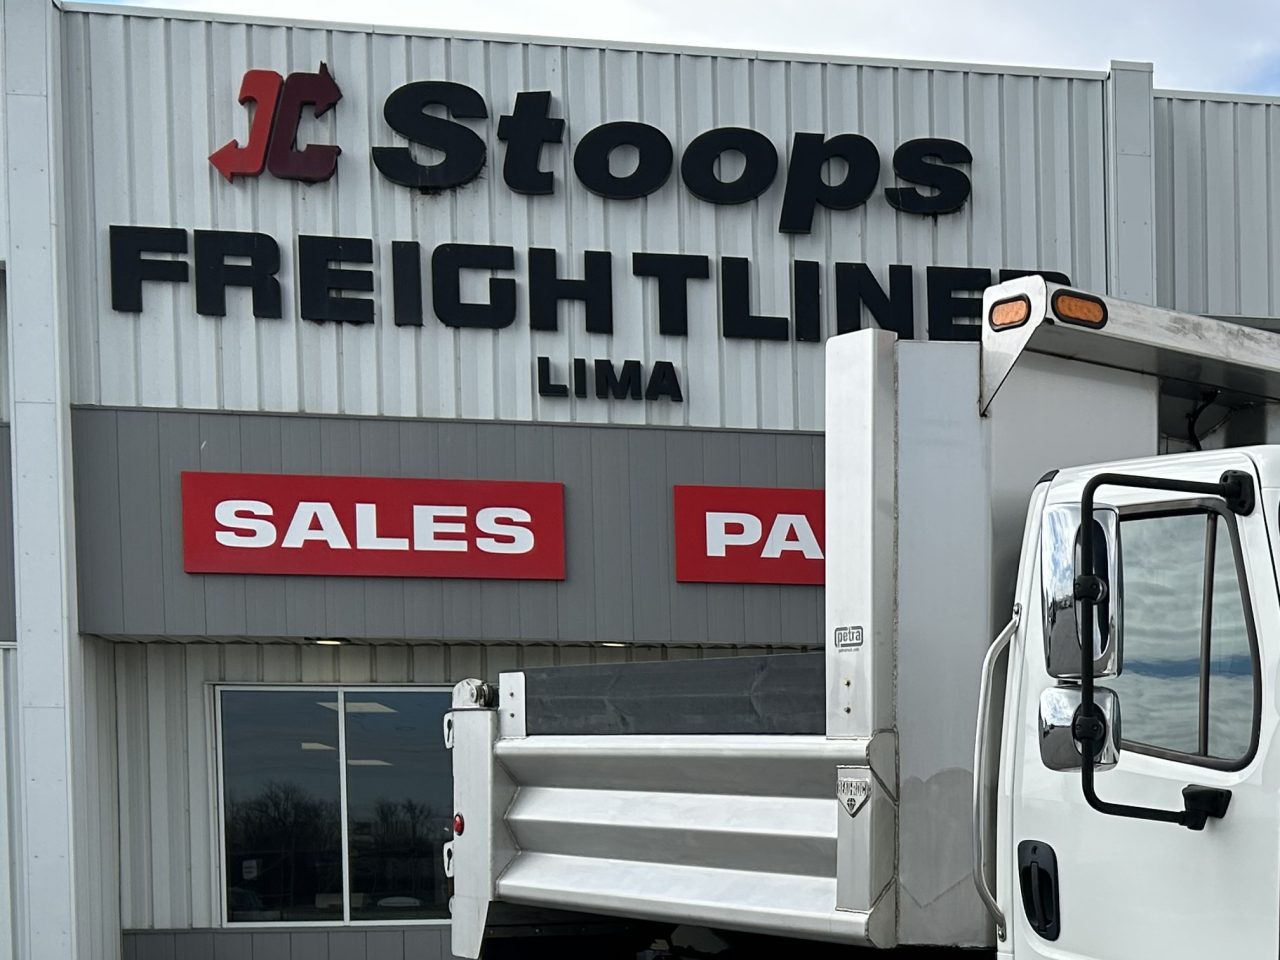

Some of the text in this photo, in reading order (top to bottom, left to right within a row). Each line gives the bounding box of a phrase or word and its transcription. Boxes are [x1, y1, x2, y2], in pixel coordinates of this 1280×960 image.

[372, 81, 972, 234] Stoops
[110, 225, 1071, 341] FREIGHTLINE
[537, 356, 684, 402] LIMA
[215, 499, 534, 554] SALES
[838, 626, 860, 648] petra
